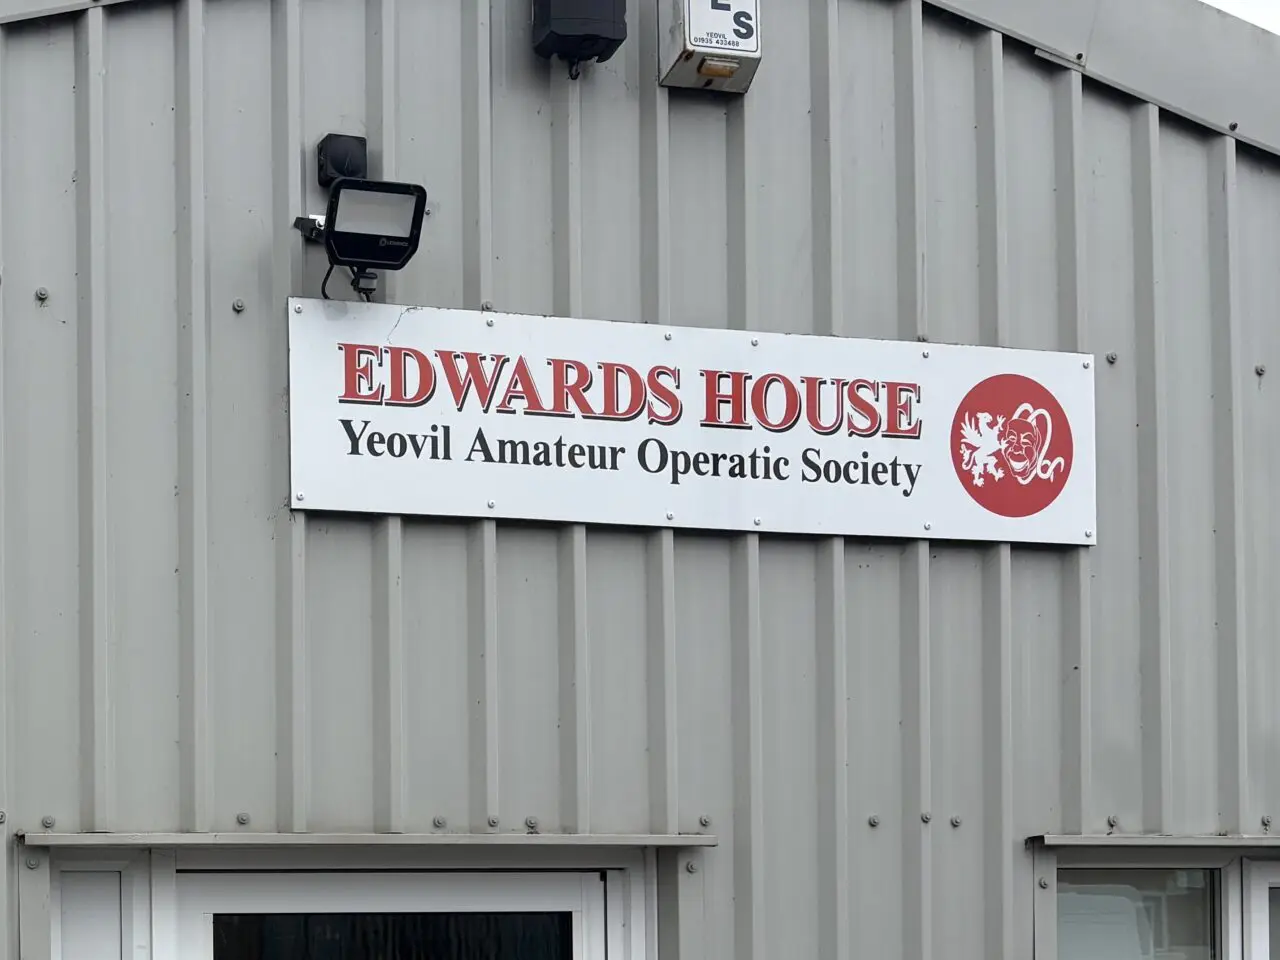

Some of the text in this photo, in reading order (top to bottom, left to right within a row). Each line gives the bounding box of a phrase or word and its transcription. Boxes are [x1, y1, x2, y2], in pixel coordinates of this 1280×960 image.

[706, 31, 727, 40] YEOVIL
[732, 10, 754, 40] S
[693, 36, 713, 45] 01935
[337, 342, 922, 440] EDWARDS HOUSE
[338, 418, 922, 498] Yeovil Amateur Operatic Society
